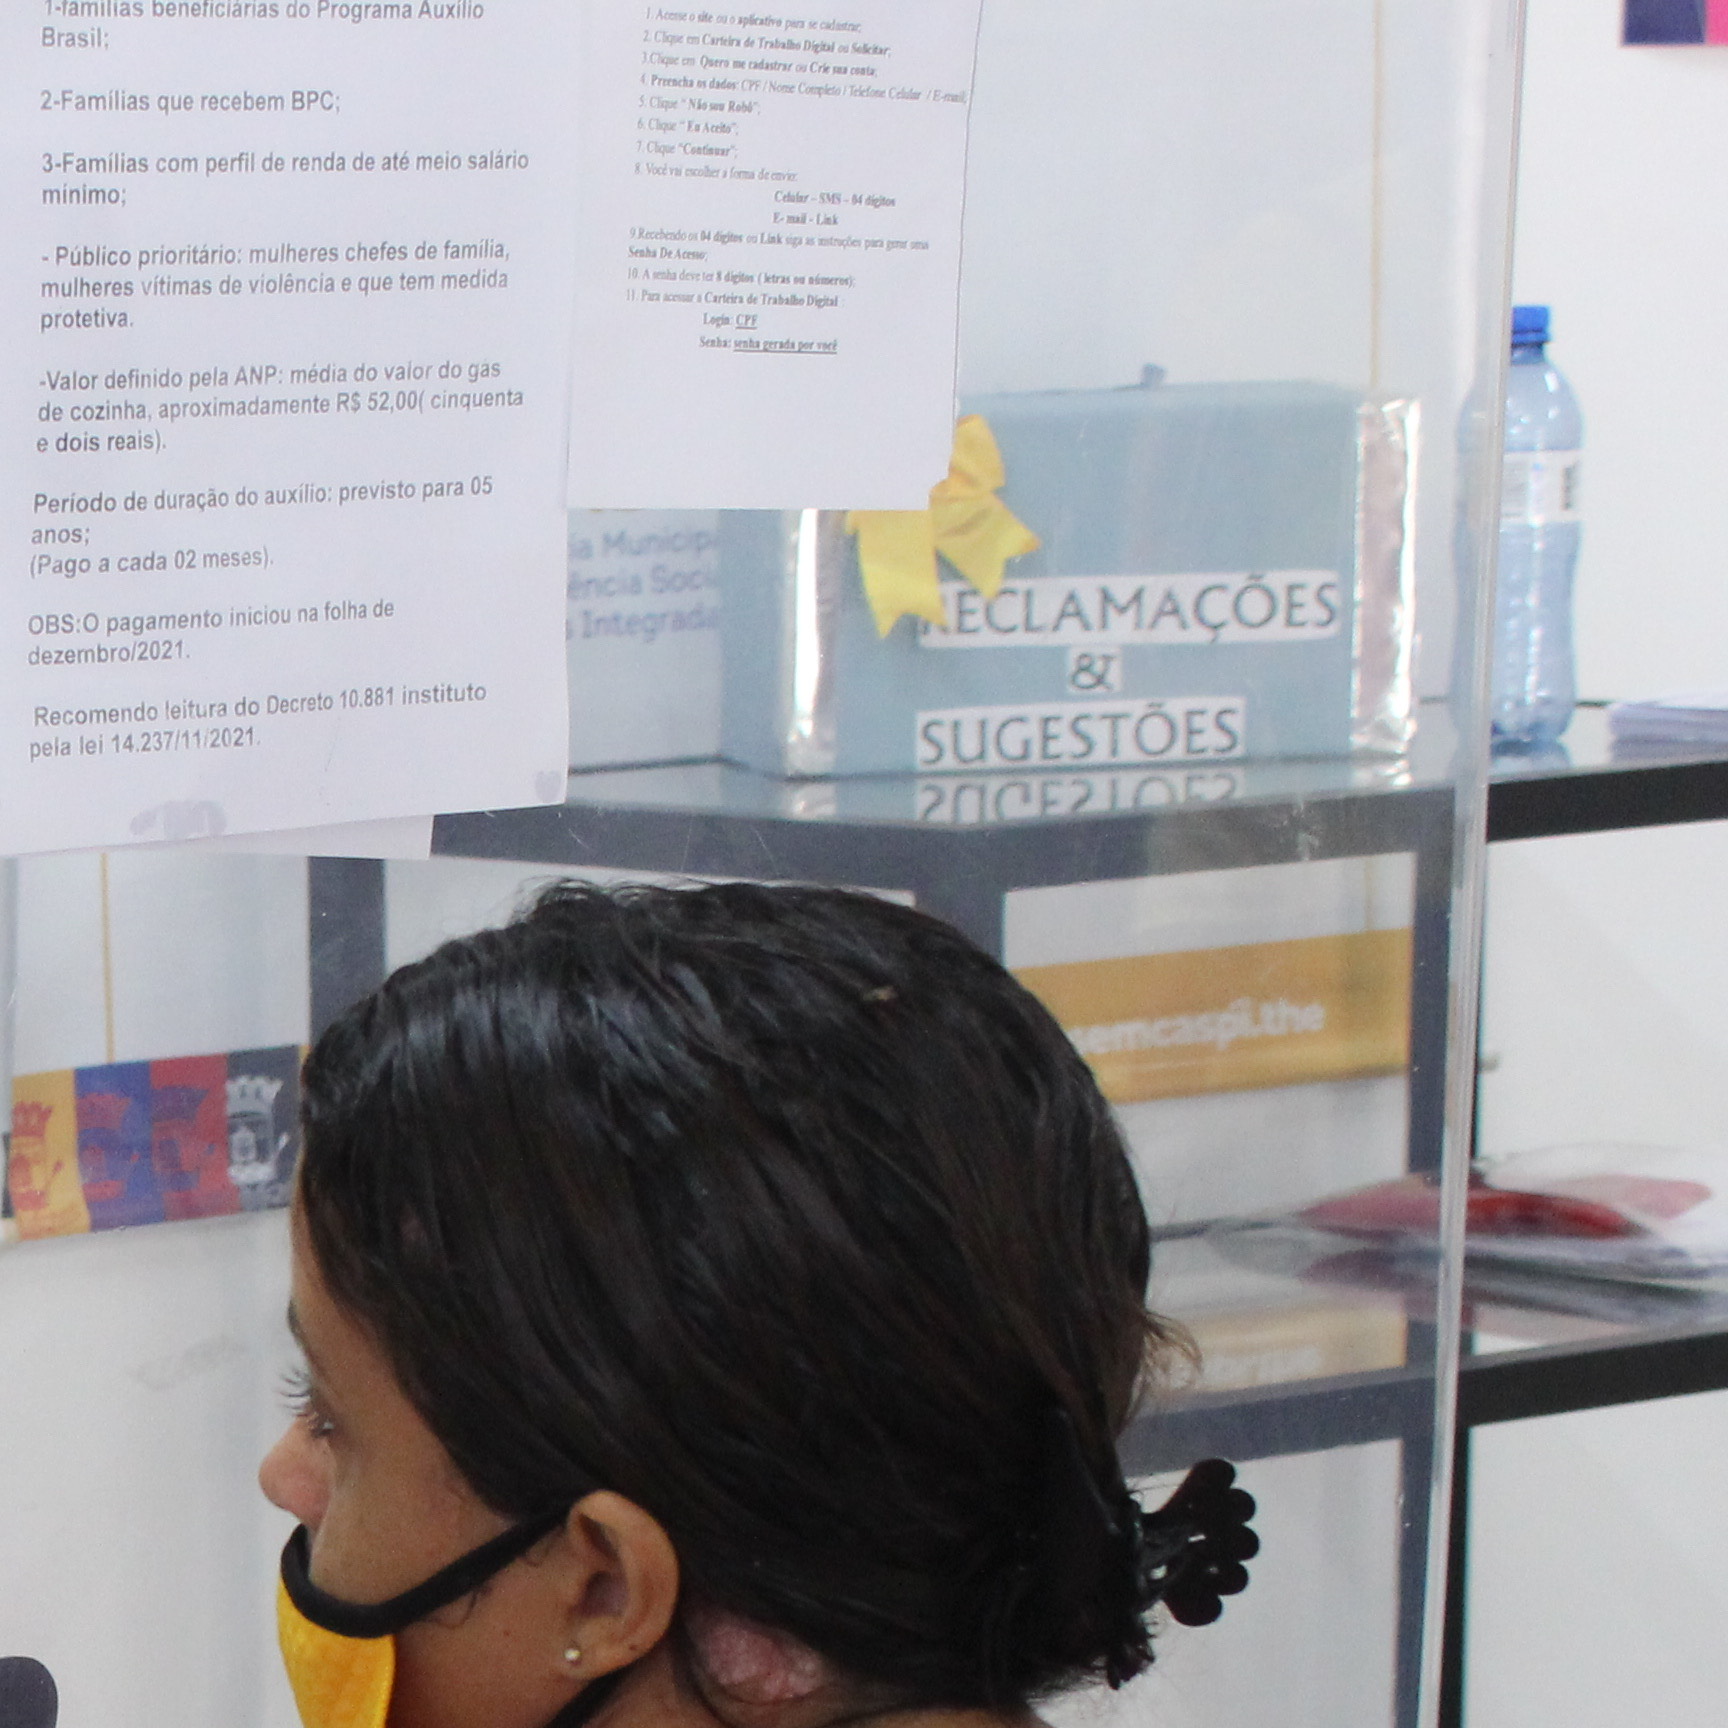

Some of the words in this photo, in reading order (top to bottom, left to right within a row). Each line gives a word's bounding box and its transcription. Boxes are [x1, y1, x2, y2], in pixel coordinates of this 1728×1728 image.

[40, 89, 151, 112] 2-Famílias
[156, 94, 195, 116] que
[200, 90, 286, 112] recebem
[291, 89, 340, 113] BPC;
[42, 182, 126, 207] mínimo;
[55, 244, 133, 267] Público
[137, 243, 242, 271] prioritário:
[248, 242, 340, 264] mulheres
[344, 240, 409, 263] chefes
[414, 240, 438, 261] de
[443, 238, 510, 261] família,
[40, 276, 135, 299] mulheres
[140, 274, 213, 297] vítimas
[218, 274, 243, 296] de
[248, 271, 336, 295] violência
[340, 276, 353, 293] e
[357, 275, 394, 297] que
[398, 272, 435, 292] tem
[440, 268, 508, 290] medida
[40, 306, 134, 334] protetiva.
[27, 638, 191, 666] dezembro/2021.
[1070, 653, 1115, 690] &
[33, 700, 159, 727] Recomendo
[164, 698, 228, 721] leitura
[233, 695, 261, 718] do
[266, 691, 334, 715] Decreto
[339, 686, 394, 709] 10.881
[401, 682, 487, 705] instituto
[921, 702, 1240, 767] SUGESTÕES
